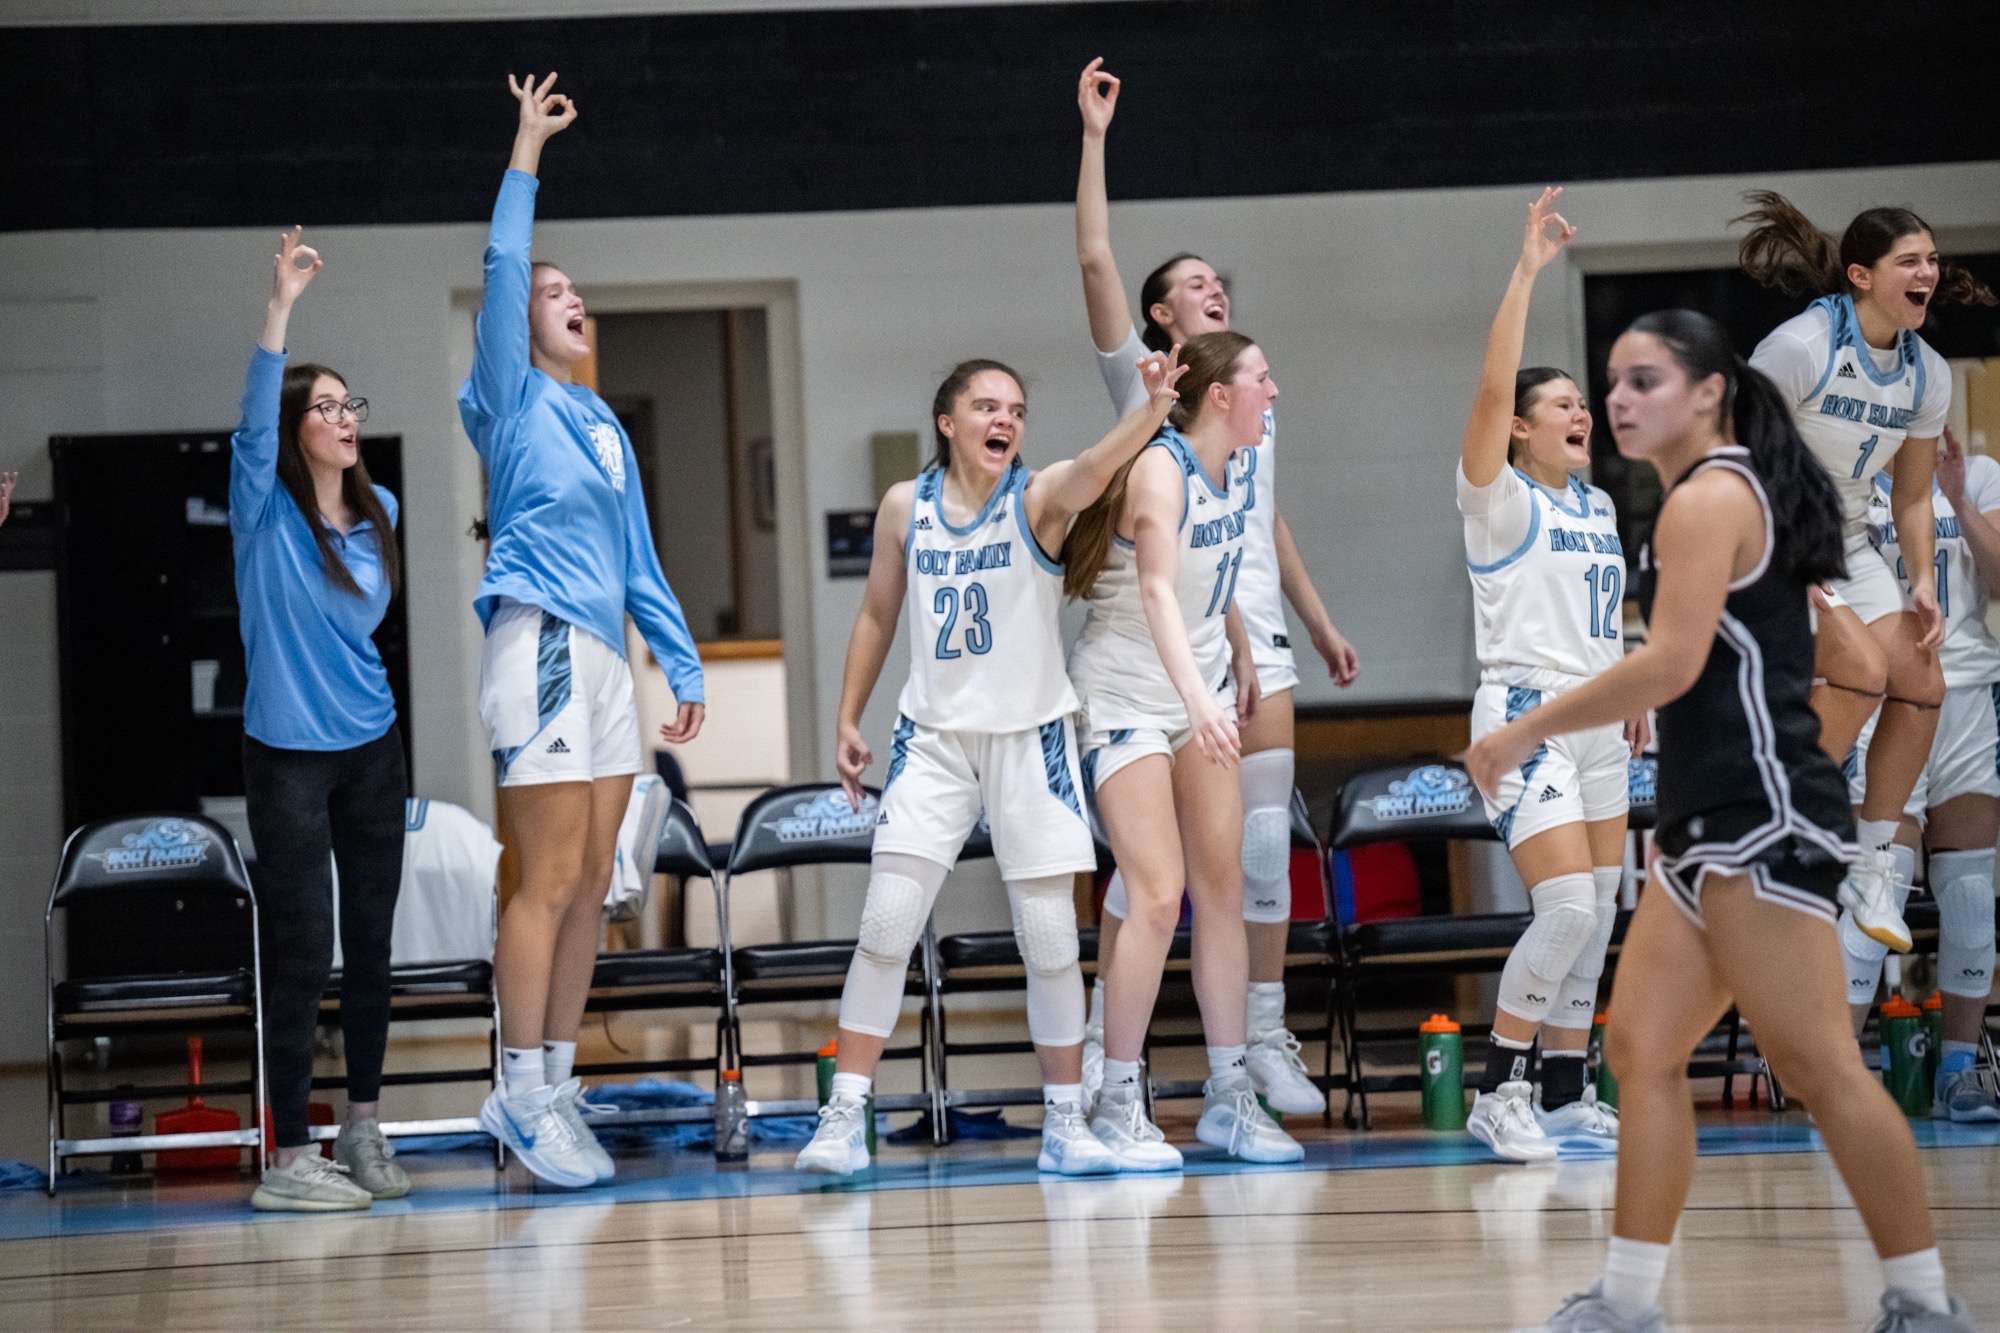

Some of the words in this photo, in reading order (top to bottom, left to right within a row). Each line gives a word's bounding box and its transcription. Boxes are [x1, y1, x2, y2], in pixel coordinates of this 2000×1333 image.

[1820, 394, 1867, 423] HOLY
[1851, 434, 1879, 479] 1
[1190, 517, 1225, 548] HOLY
[1549, 528, 1590, 552] HOLY
[916, 549, 951, 576] OLY
[1205, 547, 1243, 617] 11
[1584, 563, 1621, 639] 12
[934, 582, 993, 660] 23
[1426, 1050, 1443, 1075] G
